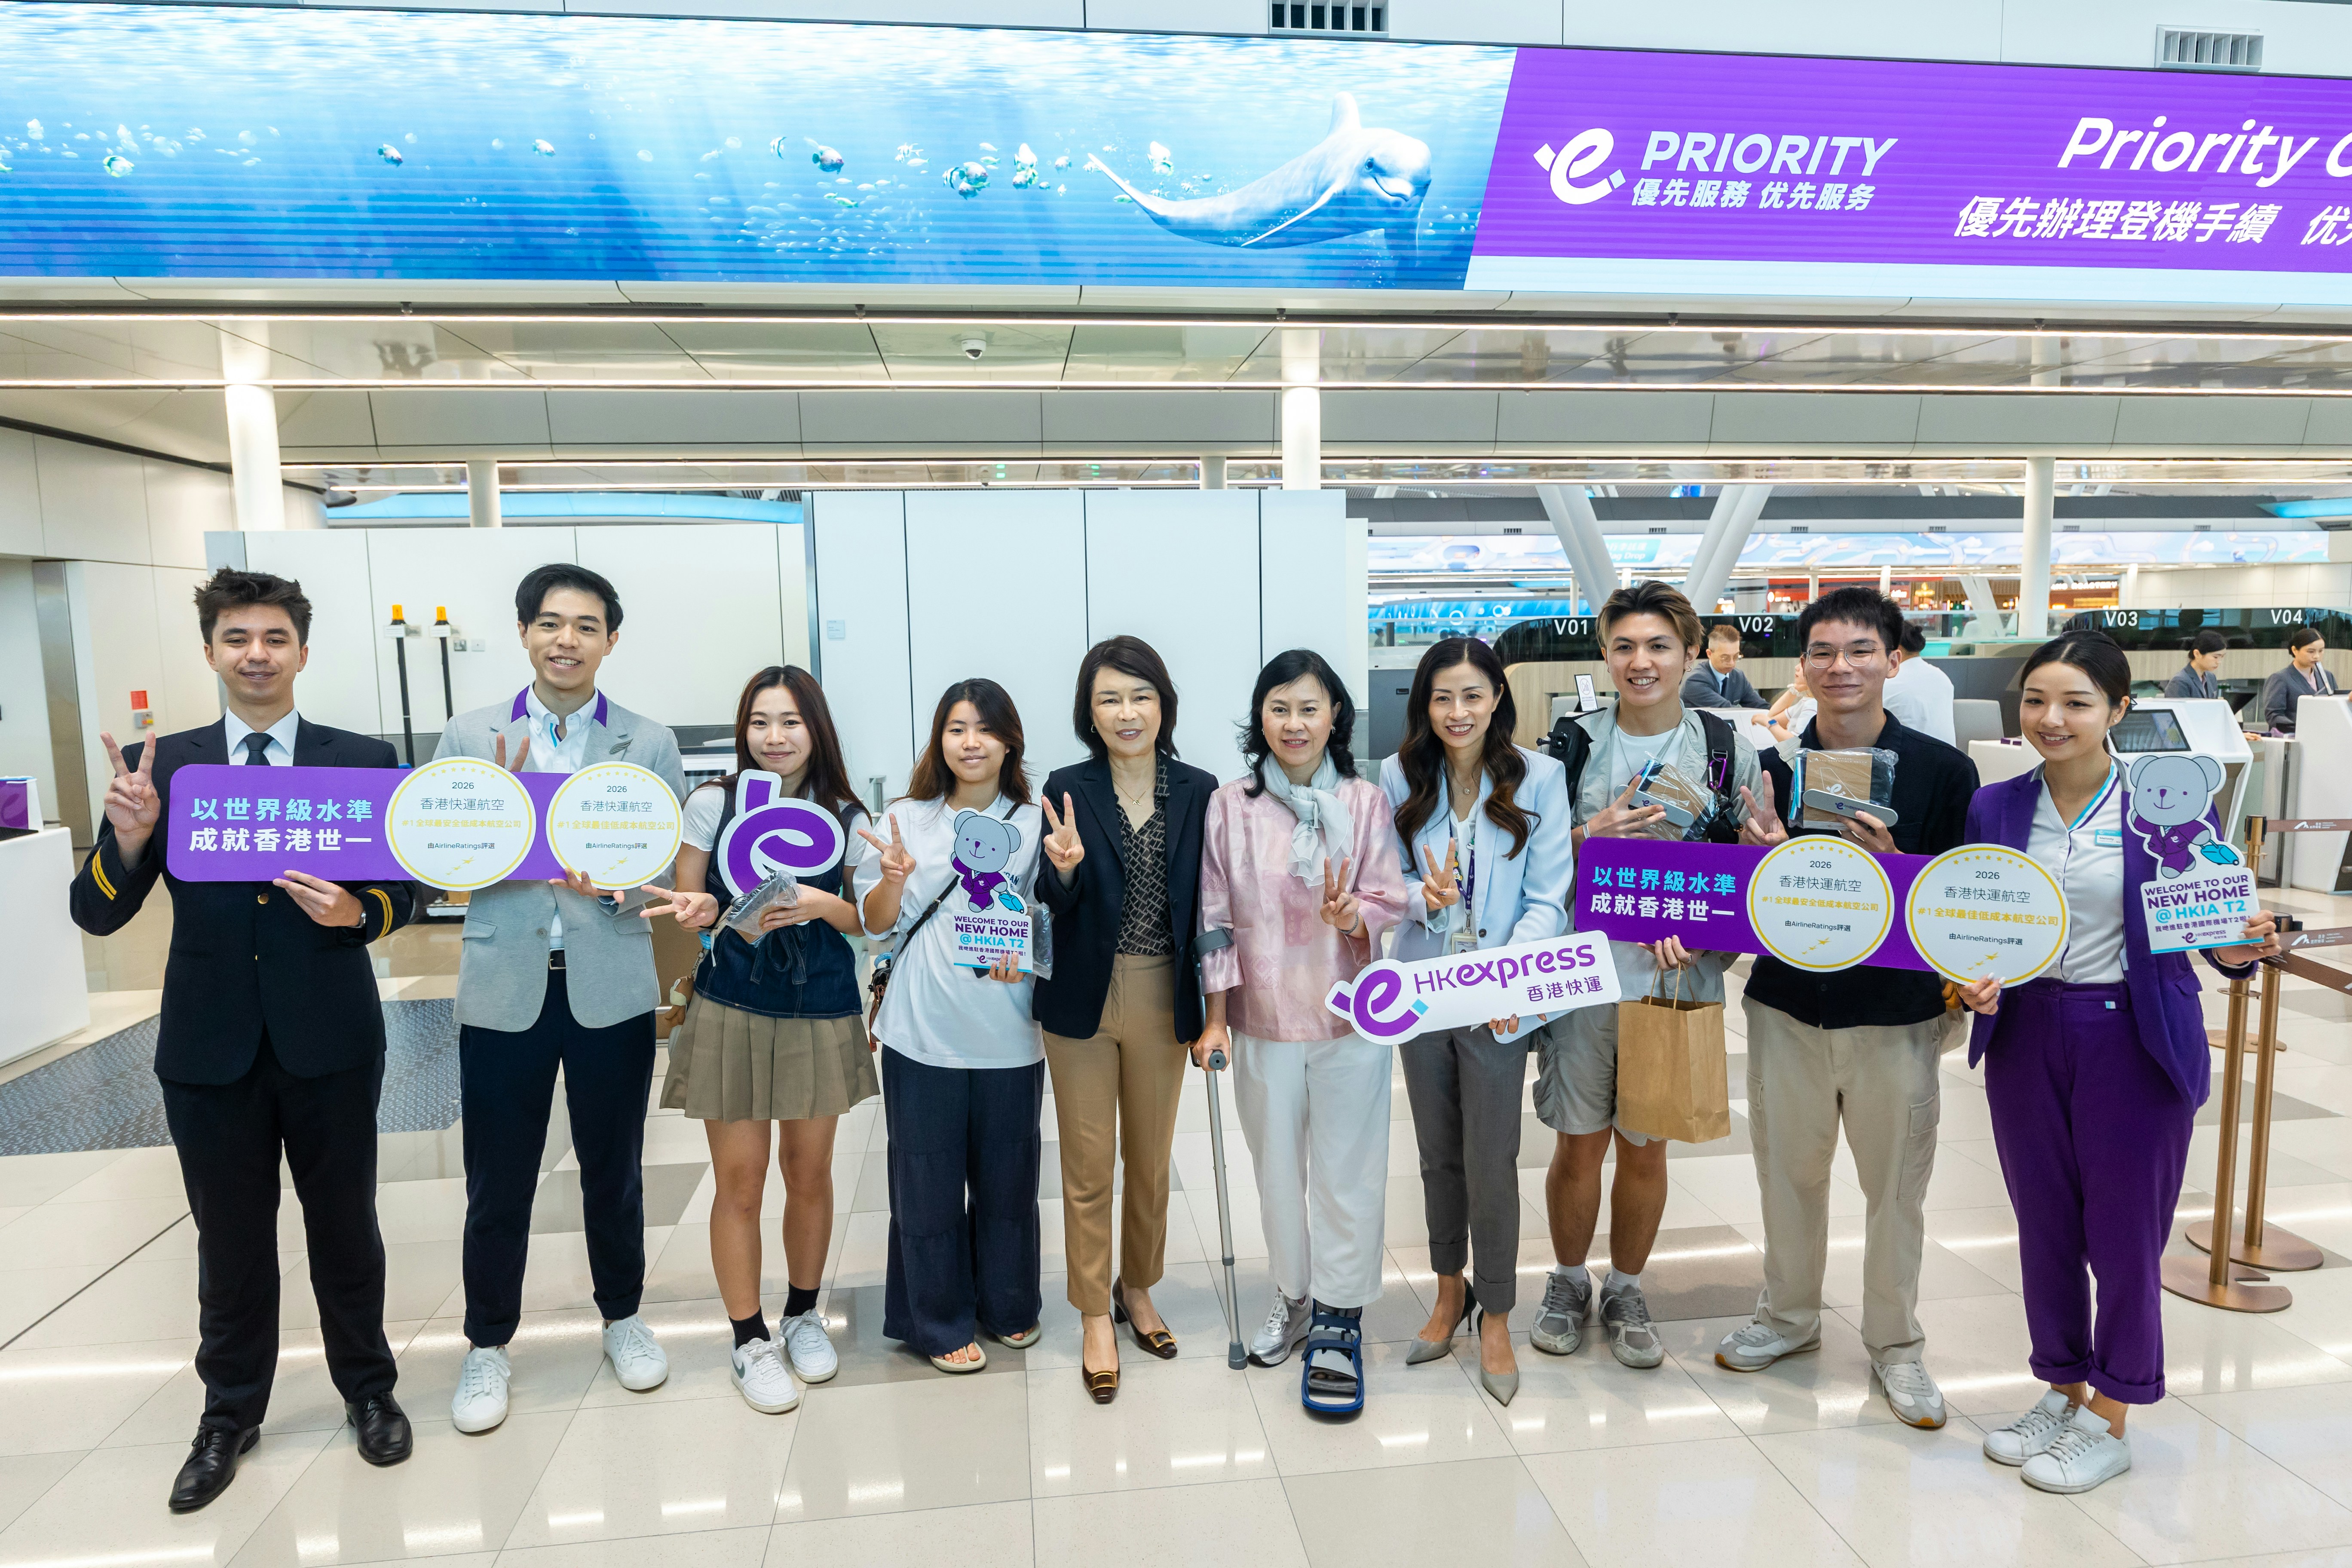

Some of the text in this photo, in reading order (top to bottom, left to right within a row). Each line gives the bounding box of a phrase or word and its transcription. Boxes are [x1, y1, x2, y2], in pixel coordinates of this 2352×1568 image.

[1641, 131, 1898, 177] PRIORITY
[2057, 116, 2320, 188] Priority
[1631, 177, 1877, 212] 優先服務 优先服务
[1953, 195, 2283, 244] 優先辦理登機手續
[1738, 616, 1773, 633] V02
[2105, 611, 2138, 627] V03
[2270, 609, 2303, 625] V04
[1554, 619, 1588, 636] V01
[451, 781, 475, 790] 2026
[190, 797, 373, 823] 以世界級水準
[420, 797, 505, 812] 香港快運航空
[580, 800, 652, 813] 香港快運航空
[416, 819, 521, 829] 全球最安全低成本航空公司
[572, 821, 675, 831] 全球最佳低成本航空公司
[189, 828, 372, 852] 成就香港世一
[428, 842, 495, 850] 由AirlineRatings評選
[585, 842, 647, 850] 由AirlineRatings評選
[1810, 860, 1832, 869] 2026
[1592, 866, 1736, 896] 以世界級水準
[1975, 870, 2000, 880] 2026
[1779, 875, 1862, 893] 香港快運航空
[2144, 874, 2248, 896] WELCOME TO OUR
[1944, 886, 2030, 904] 香港快運航空
[2147, 885, 2250, 909] NEW HOME
[1590, 892, 1735, 922] 成就香港世一
[1775, 896, 1879, 912] 全球最安全低成本航空公司
[2156, 900, 2247, 923] @ HKIA T2
[954, 916, 995, 925] WELCOME
[1917, 907, 2059, 927] #1 全球最佳低成本航空公司
[955, 923, 1028, 938] NEW HOME
[1785, 920, 1851, 932] 由AirlineRatings評選
[960, 934, 1024, 948] @ HKIA T2
[1949, 933, 2023, 946] 由AirlineRatings評選
[1413, 944, 1596, 995] HKexpress
[1526, 975, 1603, 1002] 香港快運
